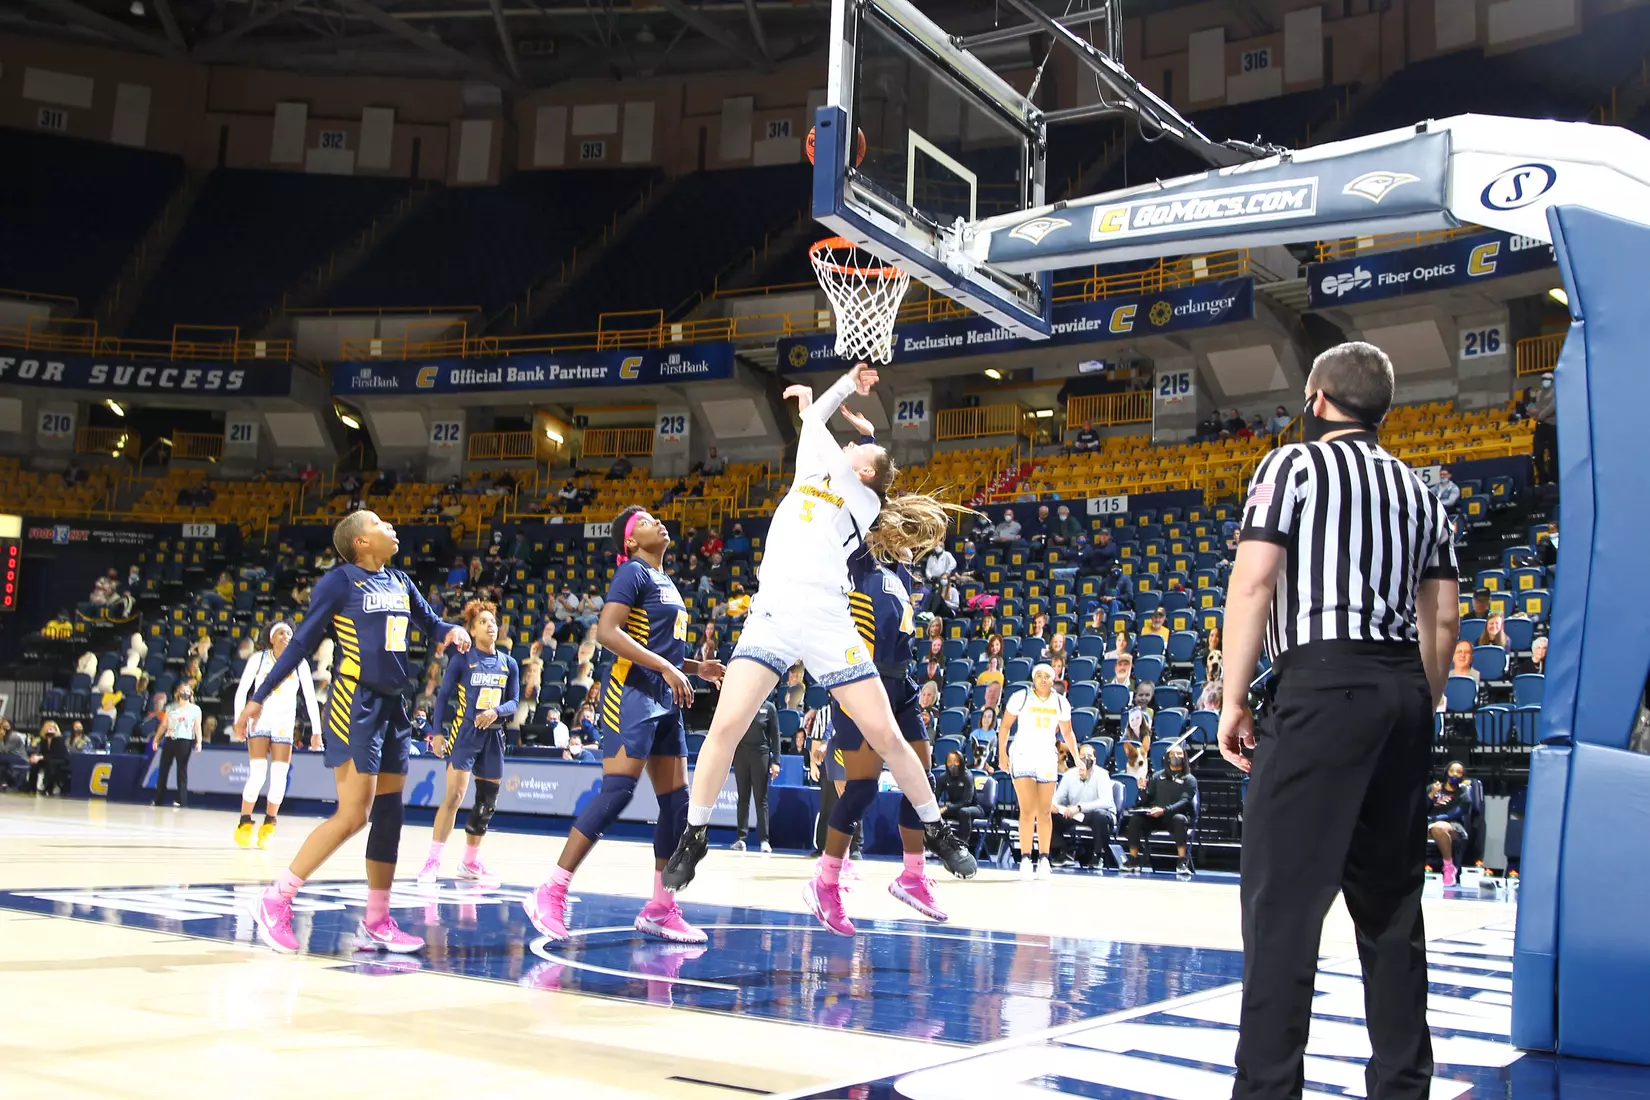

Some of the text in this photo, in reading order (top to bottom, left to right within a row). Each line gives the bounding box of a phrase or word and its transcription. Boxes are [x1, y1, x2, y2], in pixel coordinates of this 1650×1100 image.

[1244, 50, 1268, 71] 316
[40, 109, 62, 128] 311
[768, 121, 789, 138] 314
[321, 132, 344, 148] 312
[582, 142, 602, 158] 313
[1320, 265, 1373, 297] epb
[1378, 270, 1410, 286] Fiber
[1413, 263, 1456, 281] Optics
[904, 334, 964, 351] Exclusive
[966, 327, 1021, 344] Healthc
[1051, 318, 1102, 334] rovider
[1174, 296, 1236, 316] erlanger
[1464, 328, 1500, 355] 216
[0, 357, 245, 390] FOR SUCCESS
[352, 374, 400, 388] FirstBank
[450, 367, 502, 384] Official
[506, 365, 545, 382] Bank
[549, 365, 608, 380] Partner
[660, 359, 709, 375] FirstBank
[1160, 372, 1190, 396] 215
[897, 400, 925, 420] 214
[42, 413, 71, 433] 210
[230, 424, 252, 441] 211
[434, 424, 460, 441] 212
[660, 416, 685, 434] 213
[1094, 498, 1119, 512] 115
[189, 525, 210, 536] 112
[590, 525, 611, 536] 114
